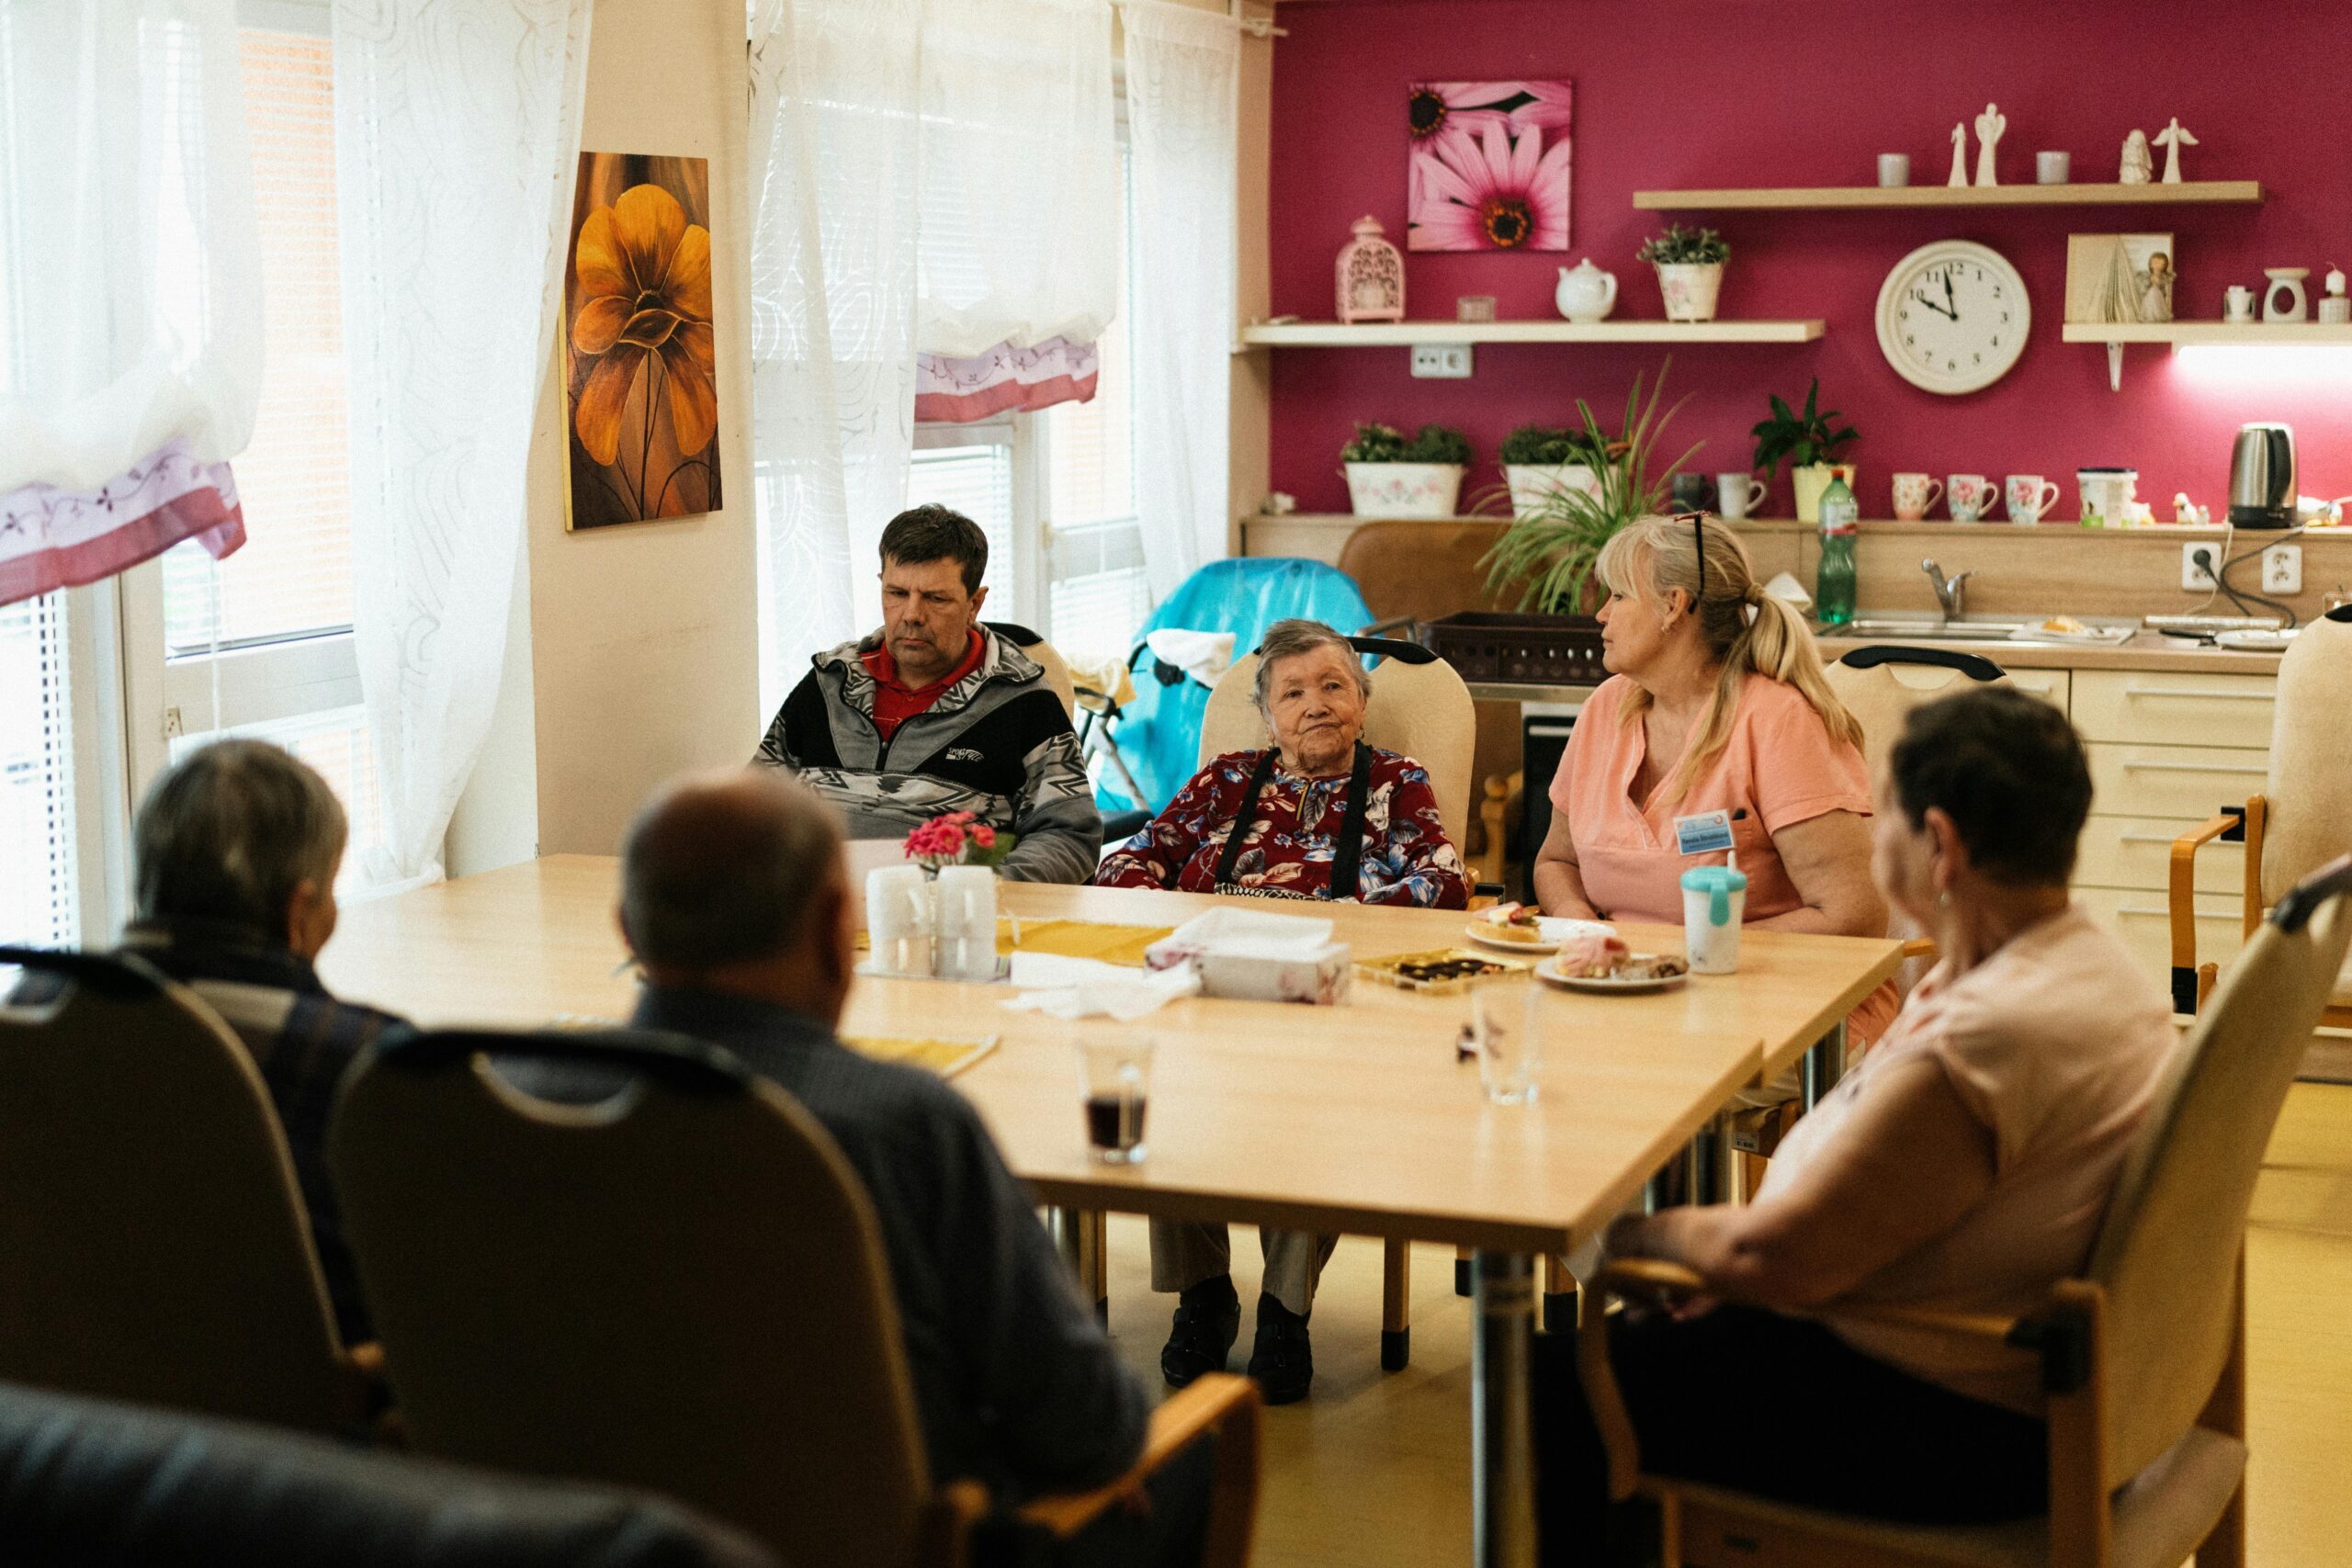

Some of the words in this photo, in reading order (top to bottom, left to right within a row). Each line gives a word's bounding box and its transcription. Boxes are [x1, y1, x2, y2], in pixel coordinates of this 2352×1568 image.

[1949, 263, 1963, 275] 12
[1927, 271, 1939, 282] 11
[1977, 270, 1982, 281] 1
[1910, 288, 1925, 299] 10
[1993, 286, 2000, 298] 2
[1900, 310, 1907, 320] 9
[2000, 312, 2007, 323] 3
[1906, 336, 1914, 345] 8
[1991, 336, 1997, 346] 4
[1925, 351, 1932, 362] 7
[1973, 353, 1980, 363] 5
[1948, 361, 1955, 371] 6
[948, 748, 967, 756] SPORT
